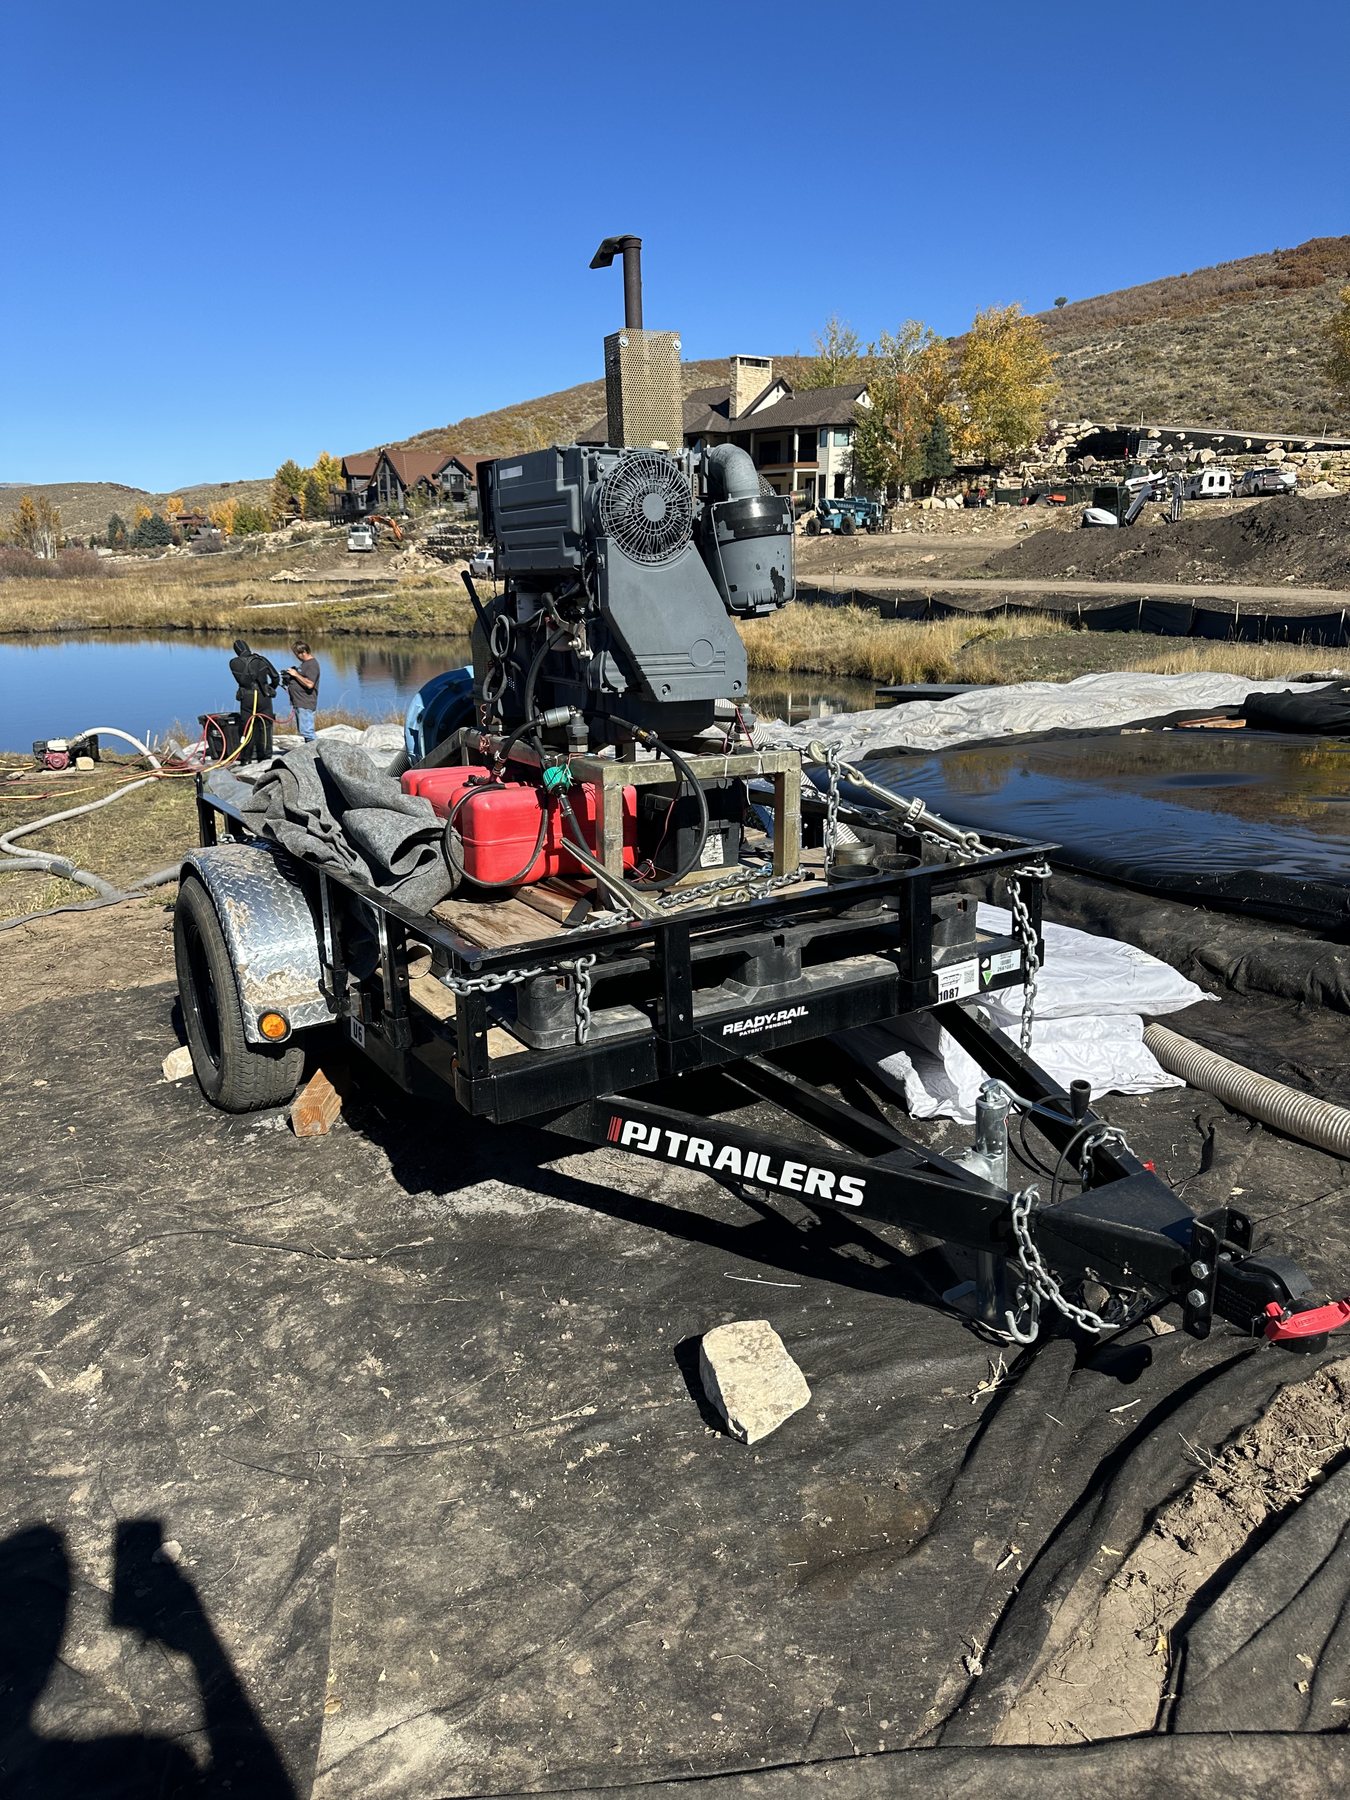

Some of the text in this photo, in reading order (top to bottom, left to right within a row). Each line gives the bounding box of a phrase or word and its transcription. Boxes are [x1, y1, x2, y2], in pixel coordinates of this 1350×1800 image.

[937, 986, 959, 1001] 1087
[738, 1019, 793, 1037] PATENT PENDING
[621, 1120, 866, 1207] PJ TRAILERS
